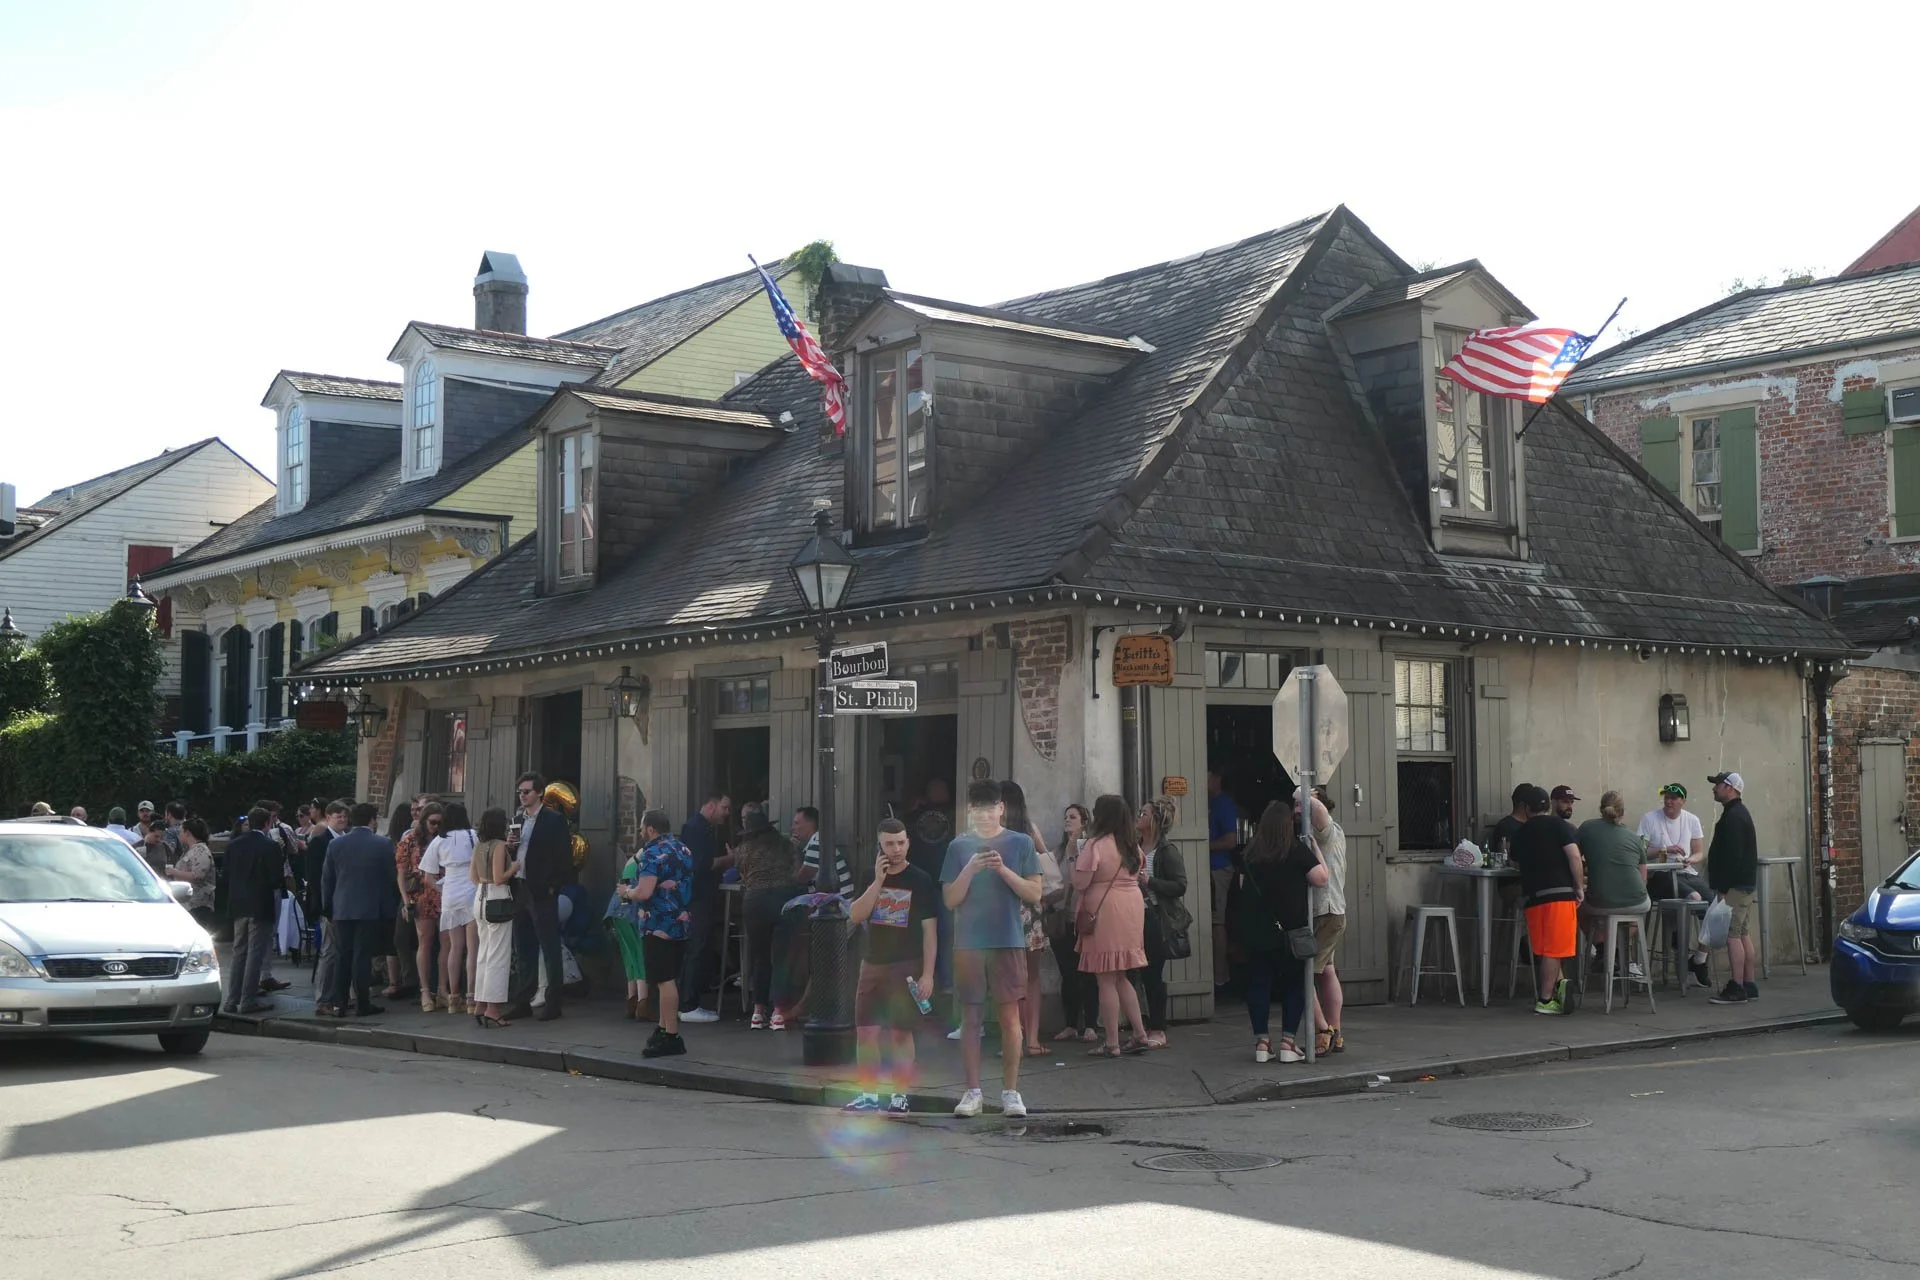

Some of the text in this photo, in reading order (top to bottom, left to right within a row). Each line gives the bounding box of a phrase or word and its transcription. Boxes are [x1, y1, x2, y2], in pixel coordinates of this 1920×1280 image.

[833, 656, 885, 676] Bourbon
[838, 690, 913, 710] St. Philip
[107, 963, 124, 971] KIA
